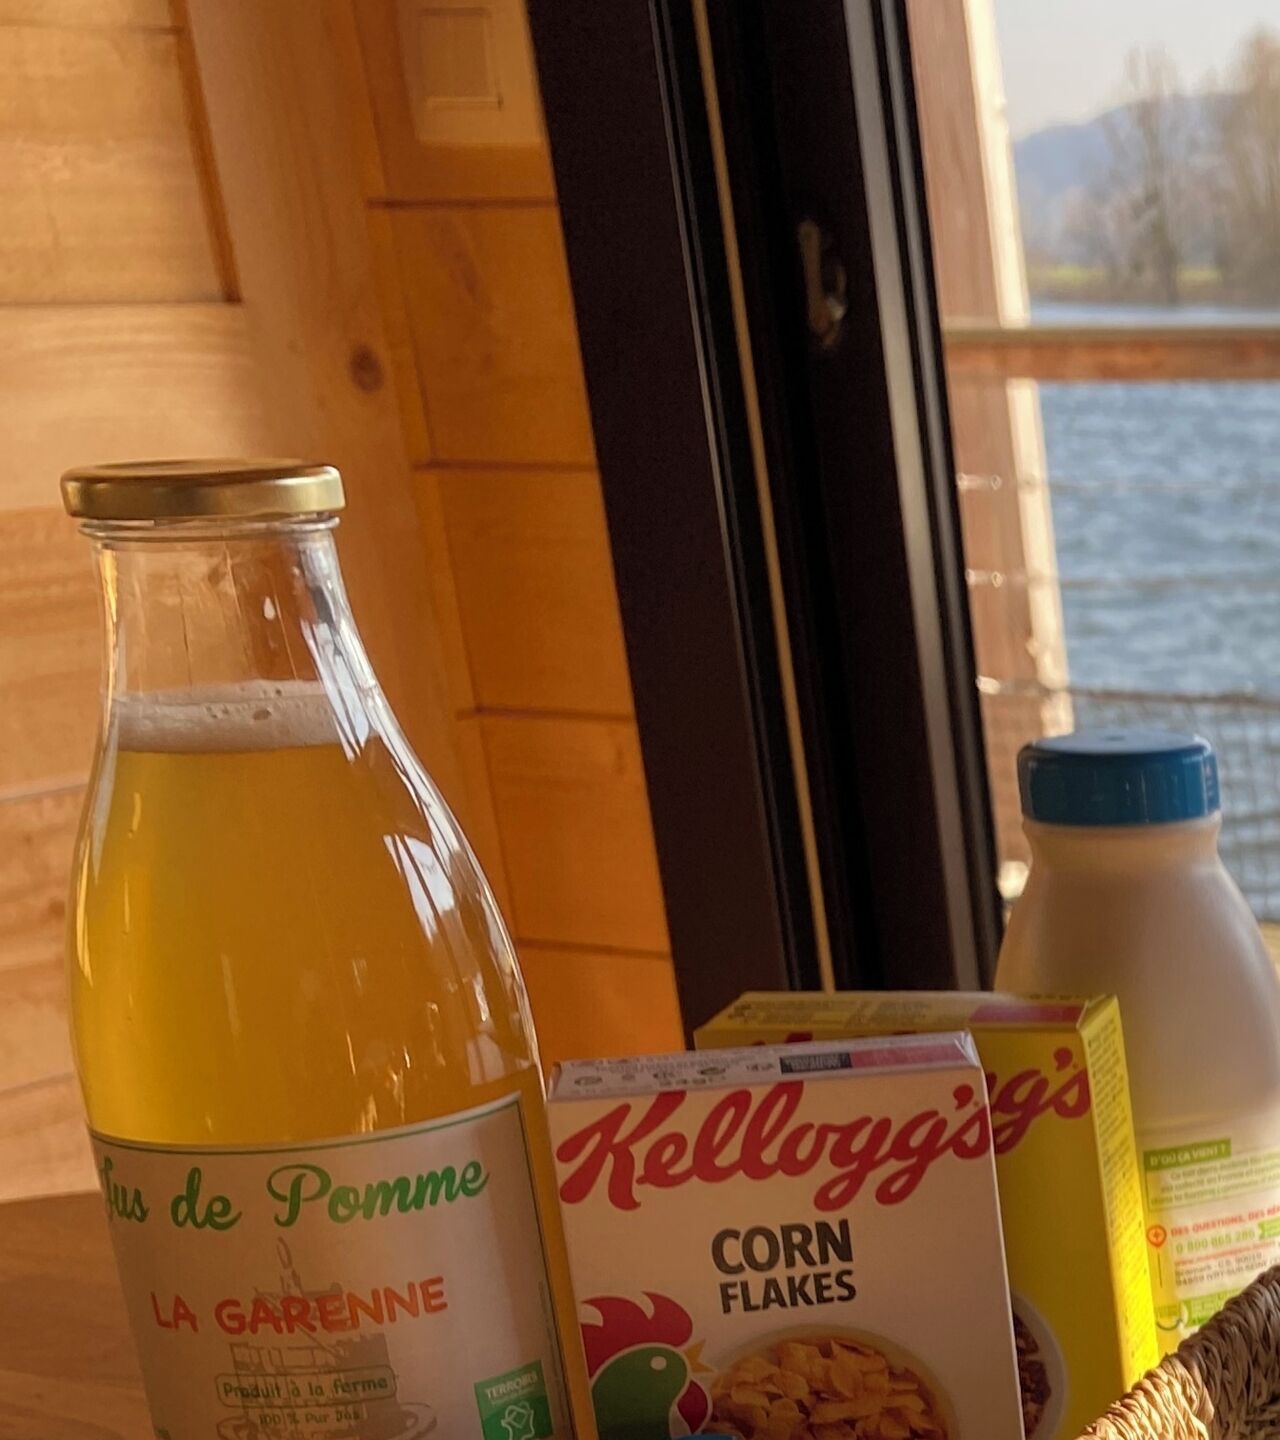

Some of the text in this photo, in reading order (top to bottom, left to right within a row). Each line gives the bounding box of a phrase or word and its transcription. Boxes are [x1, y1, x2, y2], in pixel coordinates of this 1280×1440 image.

[556, 1081, 993, 1211] Kellogg's
[170, 1167, 242, 1230] de
[267, 1160, 490, 1227] Pomme
[711, 1219, 854, 1275] CORN
[150, 1276, 448, 1335] LA GARENNE
[720, 1269, 856, 1314] FLAKES
[223, 1381, 282, 1400] Produit
[309, 1381, 325, 1397] la
[333, 1376, 388, 1395] ferme
[259, 1412, 281, 1426] 100
